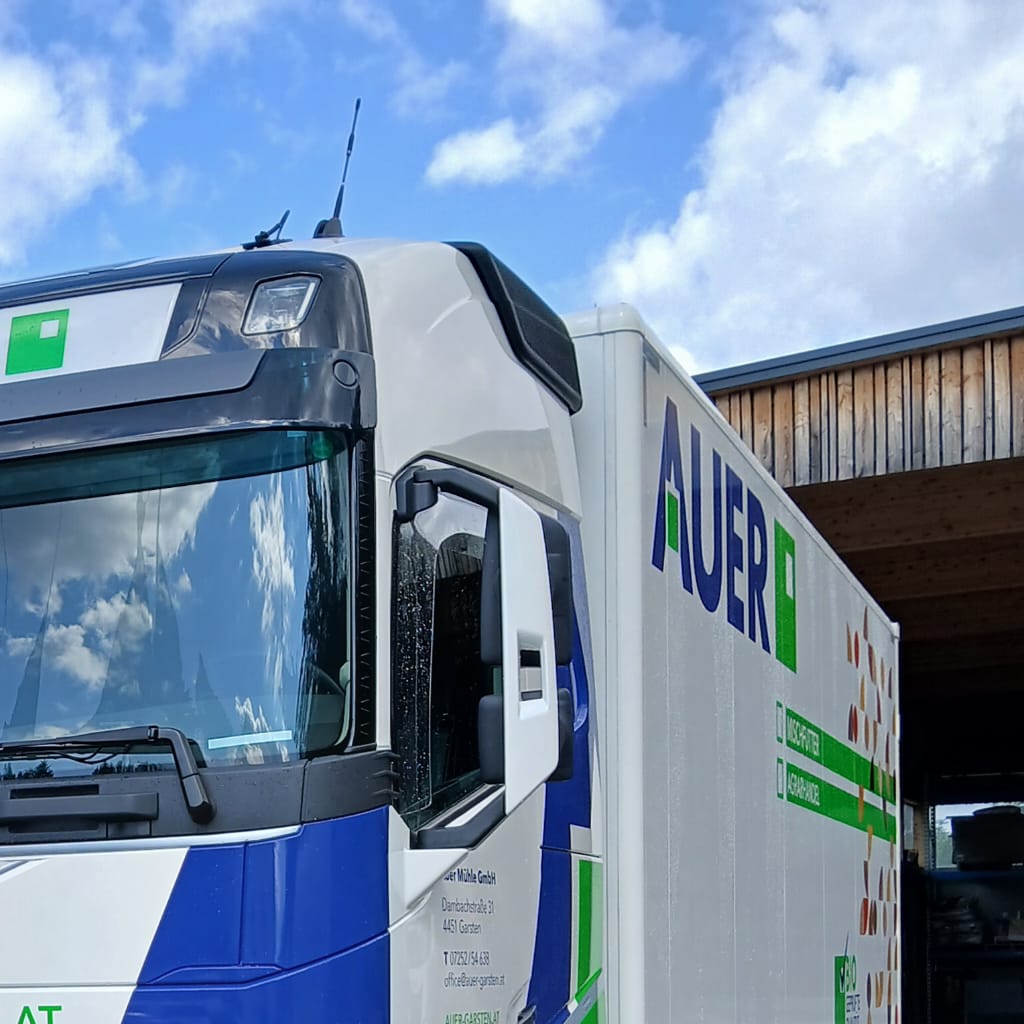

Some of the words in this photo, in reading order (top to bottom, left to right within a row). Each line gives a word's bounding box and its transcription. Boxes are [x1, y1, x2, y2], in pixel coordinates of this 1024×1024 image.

[651, 395, 771, 655] AUER
[443, 870, 456, 882] uer
[457, 868, 477, 884] Mühle
[477, 870, 496, 885] GmbH
[442, 897, 487, 914] Dambachstraße
[488, 900, 495, 914] 31
[443, 920, 457, 933] 4451
[459, 919, 481, 934] Garsten
[443, 951, 449, 965] T
